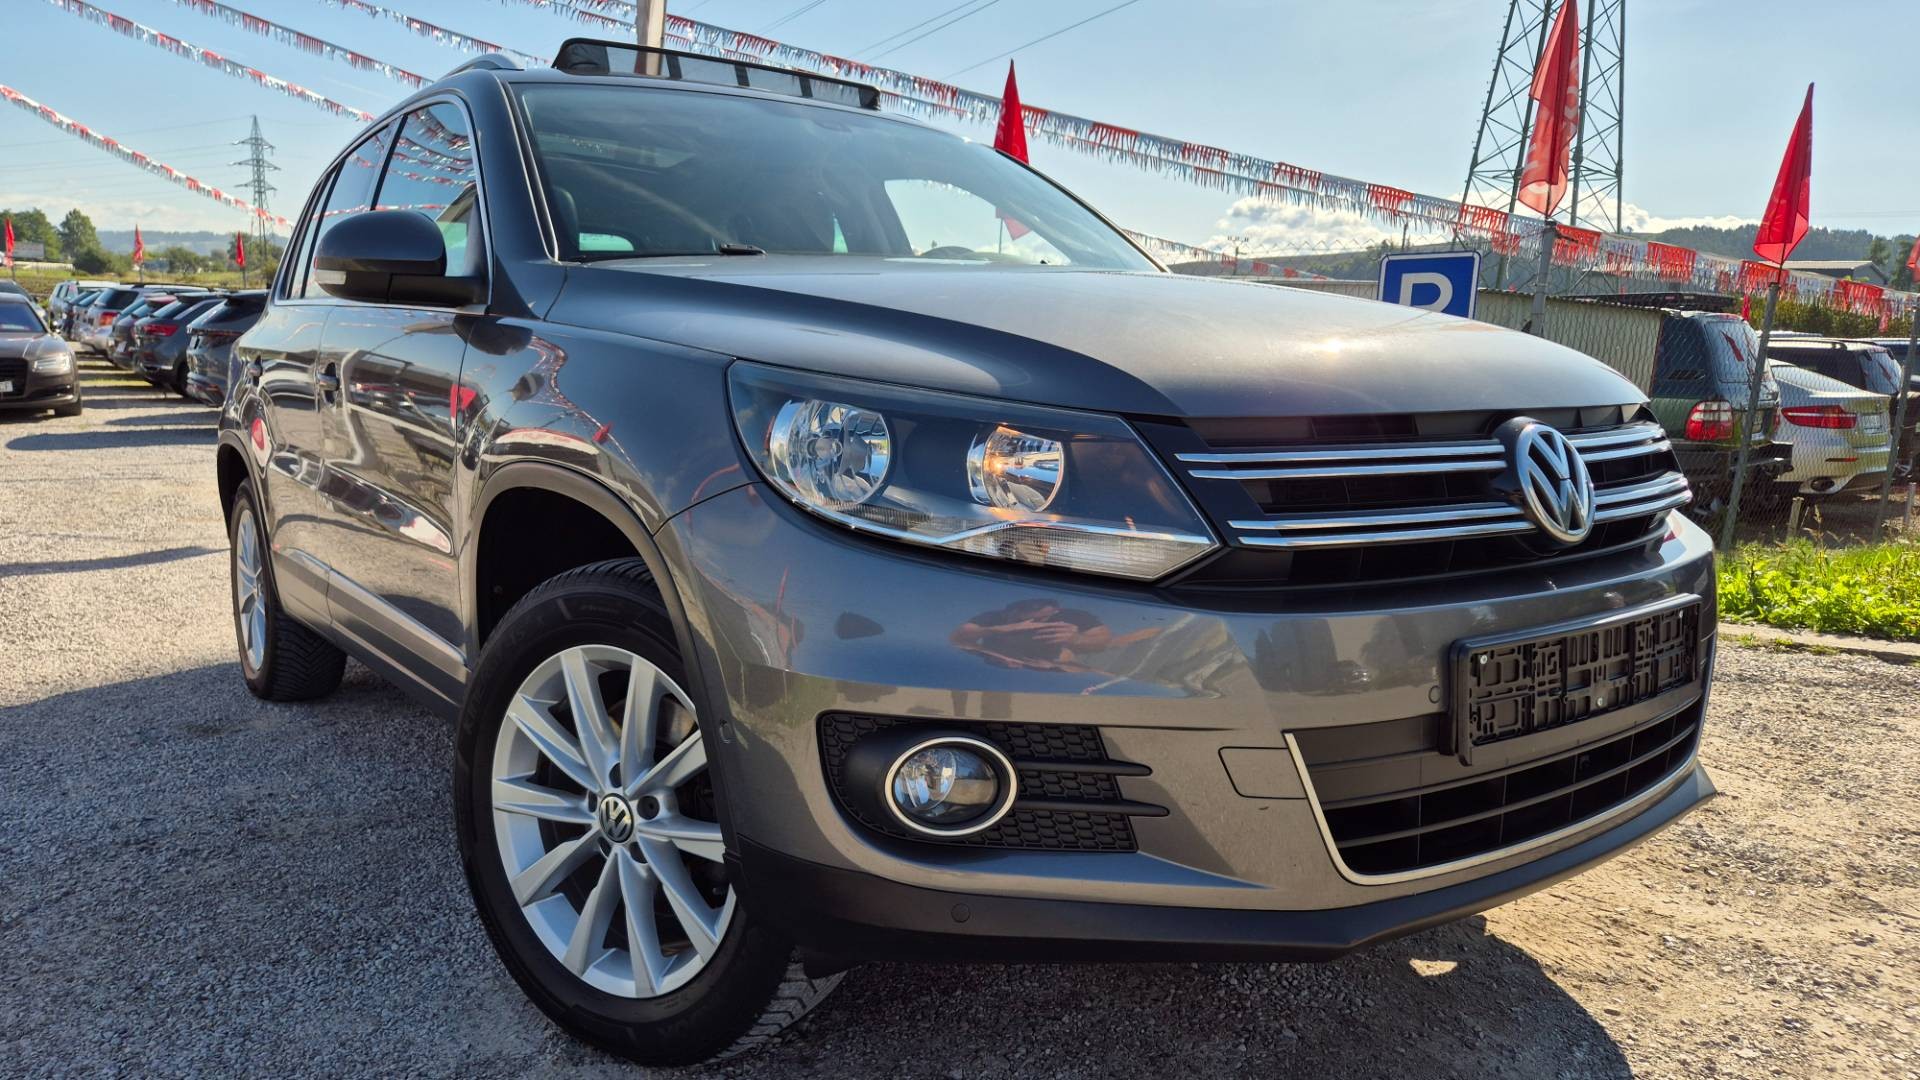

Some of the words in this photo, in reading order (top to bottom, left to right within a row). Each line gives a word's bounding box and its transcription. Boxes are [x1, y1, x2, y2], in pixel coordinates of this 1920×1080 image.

[1399, 272, 1453, 313] P
[1518, 424, 1594, 541] VW
[600, 796, 632, 841] VW
